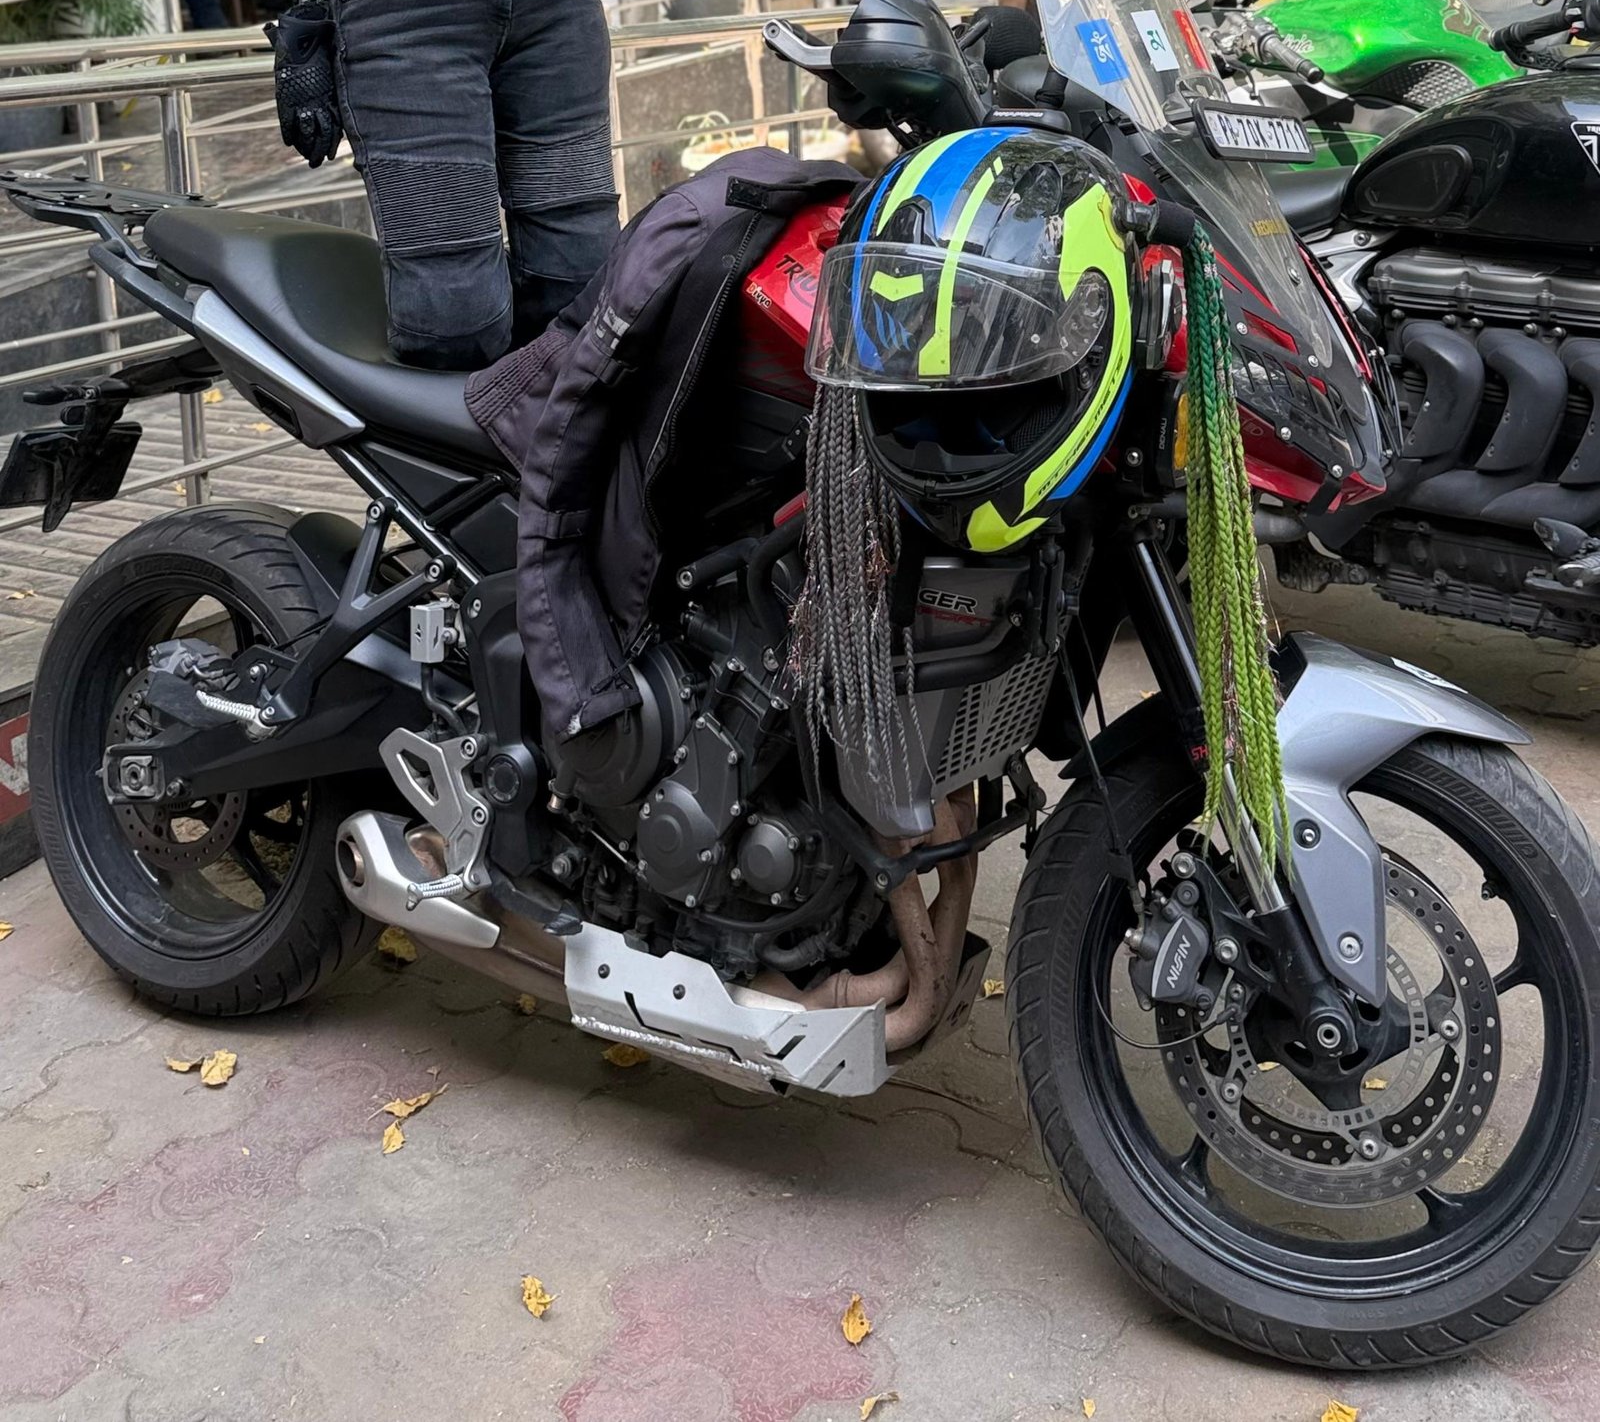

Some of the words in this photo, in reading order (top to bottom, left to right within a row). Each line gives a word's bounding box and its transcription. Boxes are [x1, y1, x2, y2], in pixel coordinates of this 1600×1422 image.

[775, 254, 820, 293] TRIU
[746, 281, 773, 309] Divya
[1158, 417, 1168, 451] DENALI
[917, 587, 979, 616] GER
[1165, 933, 1192, 990] NISSIN
